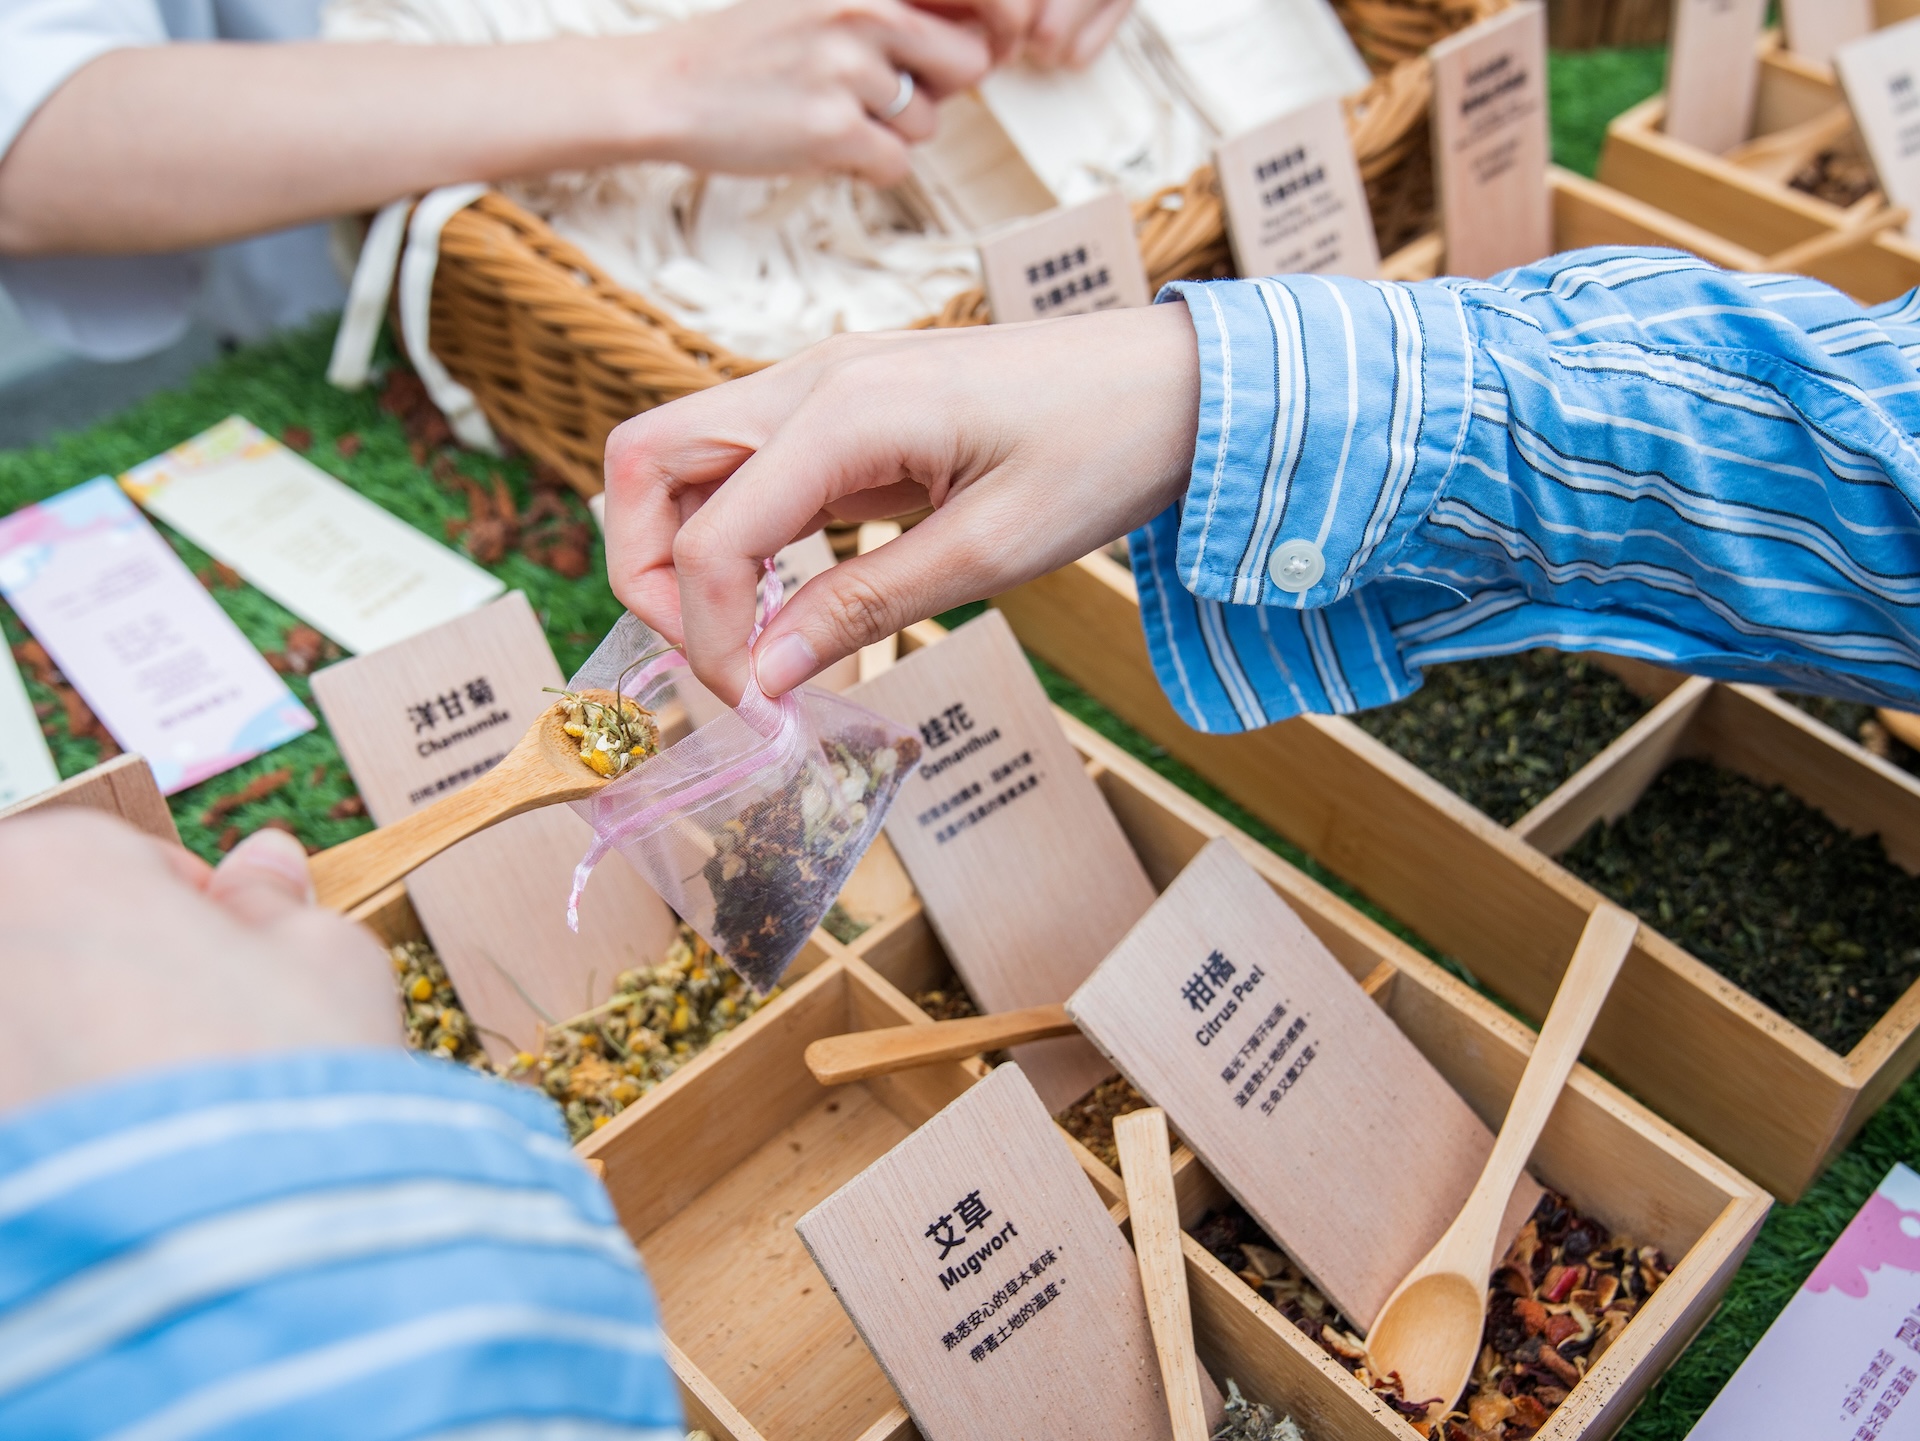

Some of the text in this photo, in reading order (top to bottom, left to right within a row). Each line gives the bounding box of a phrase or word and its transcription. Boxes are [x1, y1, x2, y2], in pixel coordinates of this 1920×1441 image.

[407, 677, 494, 733] 洋甘菊
[919, 703, 974, 749] 桂花
[1181, 949, 1236, 1013] 柑橘
[1195, 963, 1265, 1047] Citrus Peel
[924, 1189, 993, 1261] 艾草
[938, 1221, 1019, 1291] Mugwort
